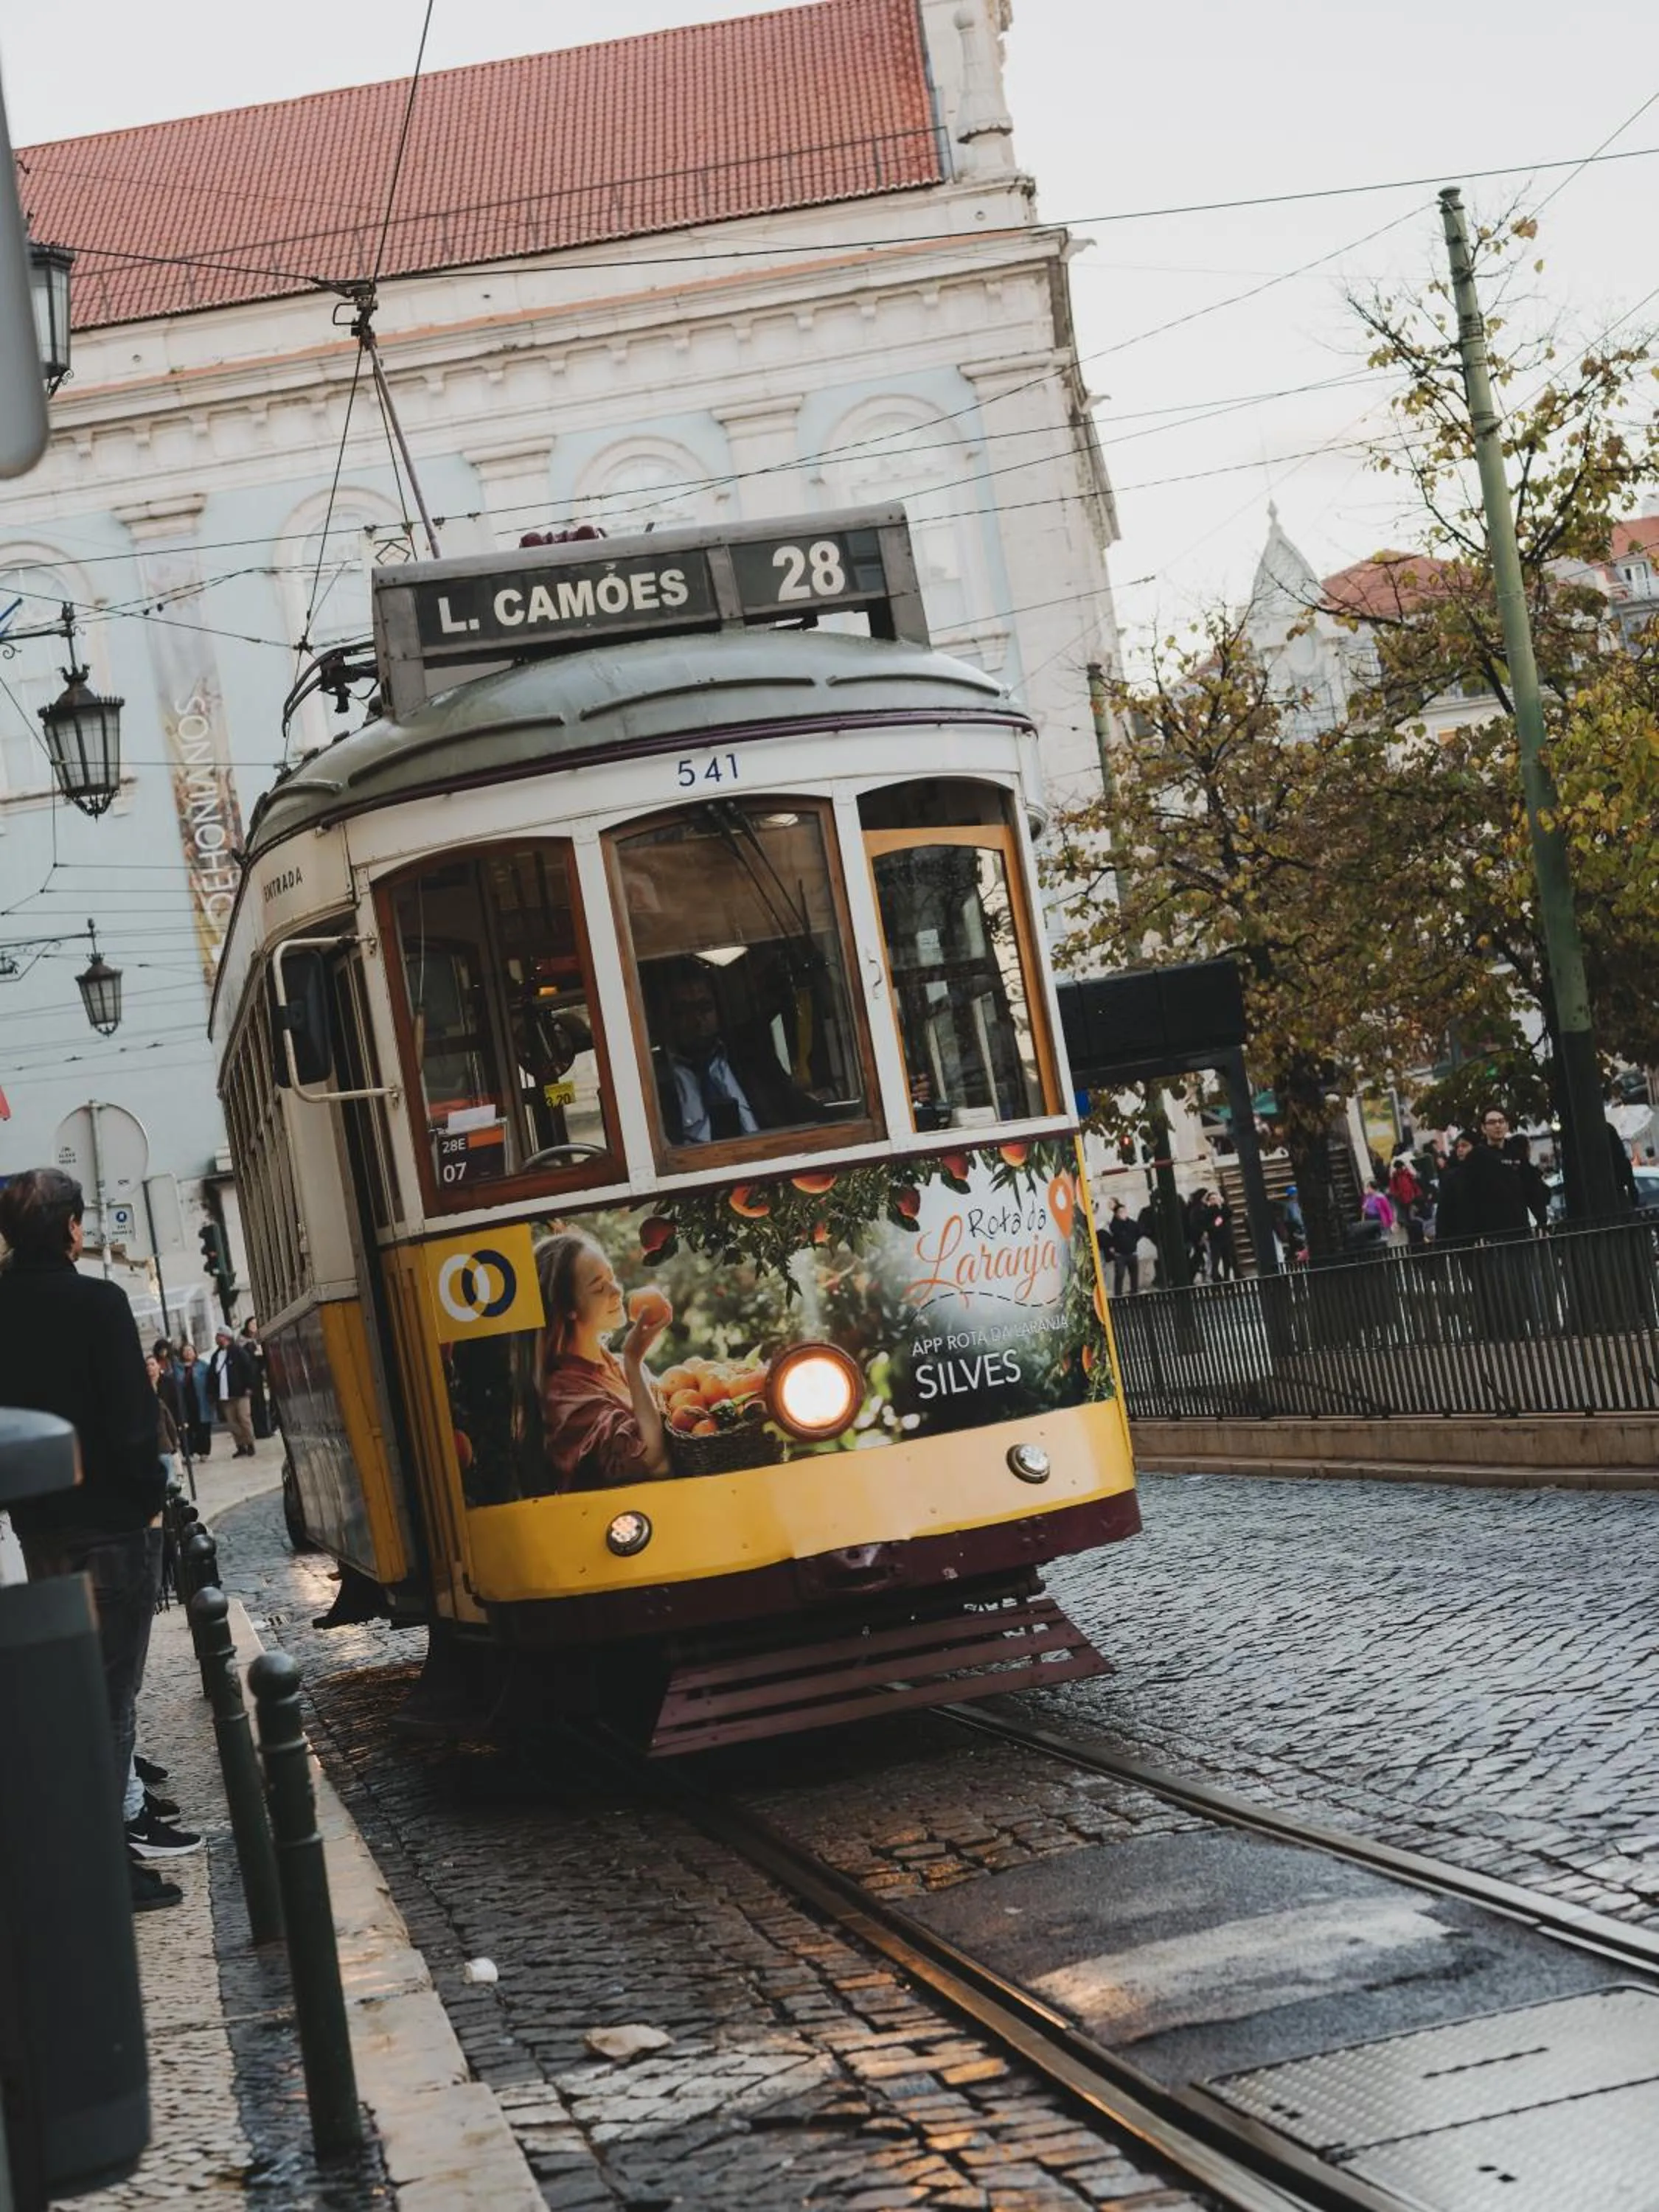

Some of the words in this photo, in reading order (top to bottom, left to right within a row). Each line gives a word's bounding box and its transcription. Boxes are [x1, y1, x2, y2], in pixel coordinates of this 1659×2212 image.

[772, 540, 846, 602] 28
[438, 597, 480, 634] L.
[678, 753, 738, 787] 541
[263, 866, 303, 902] ENTRADA
[442, 1138, 467, 1154] 28E
[443, 1161, 467, 1183] 07
[968, 1206, 1022, 1239] Rota
[900, 1214, 1058, 1310] Laranja
[912, 1336, 944, 1357] APP
[947, 1330, 988, 1351] ROTA
[1012, 1315, 1069, 1338] LARANJA
[915, 1349, 1022, 1399] SILVES
